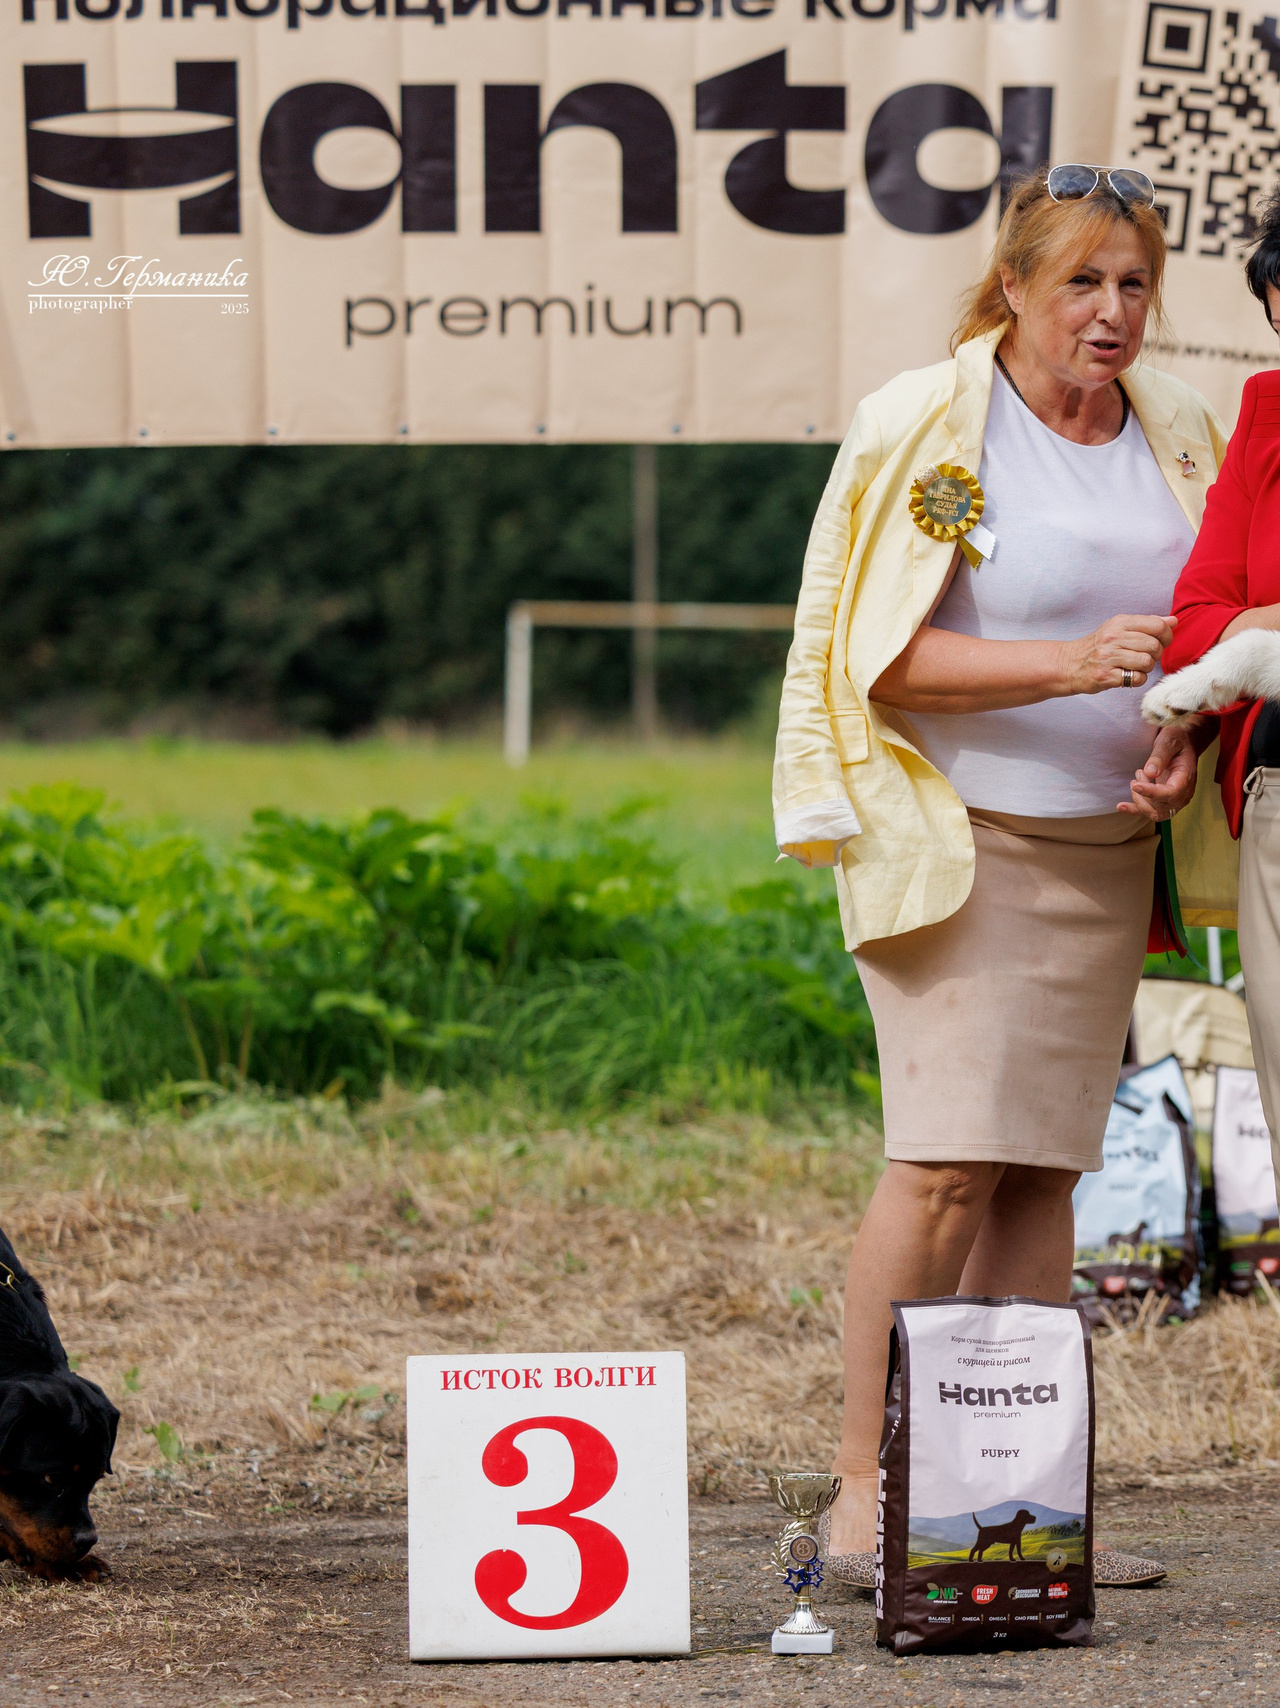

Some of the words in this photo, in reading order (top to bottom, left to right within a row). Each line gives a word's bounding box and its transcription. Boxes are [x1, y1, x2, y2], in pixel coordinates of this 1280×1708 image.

[22, 48, 1054, 239] Hanta
[344, 284, 743, 347] premium
[951, 1335, 966, 1344] Корм
[962, 1357, 996, 1368] курицей
[1003, 1356, 1031, 1368] рисом
[440, 1368, 543, 1391] ИСТОК
[554, 1366, 658, 1389] ВОЛГИ
[938, 1381, 1059, 1407] Hanta
[973, 1410, 1022, 1419] premium
[980, 1448, 1020, 1458] PUPPY
[474, 1415, 630, 1631] 3
[976, 1587, 994, 1595] FRESH
[976, 1593, 991, 1601] MEAT
